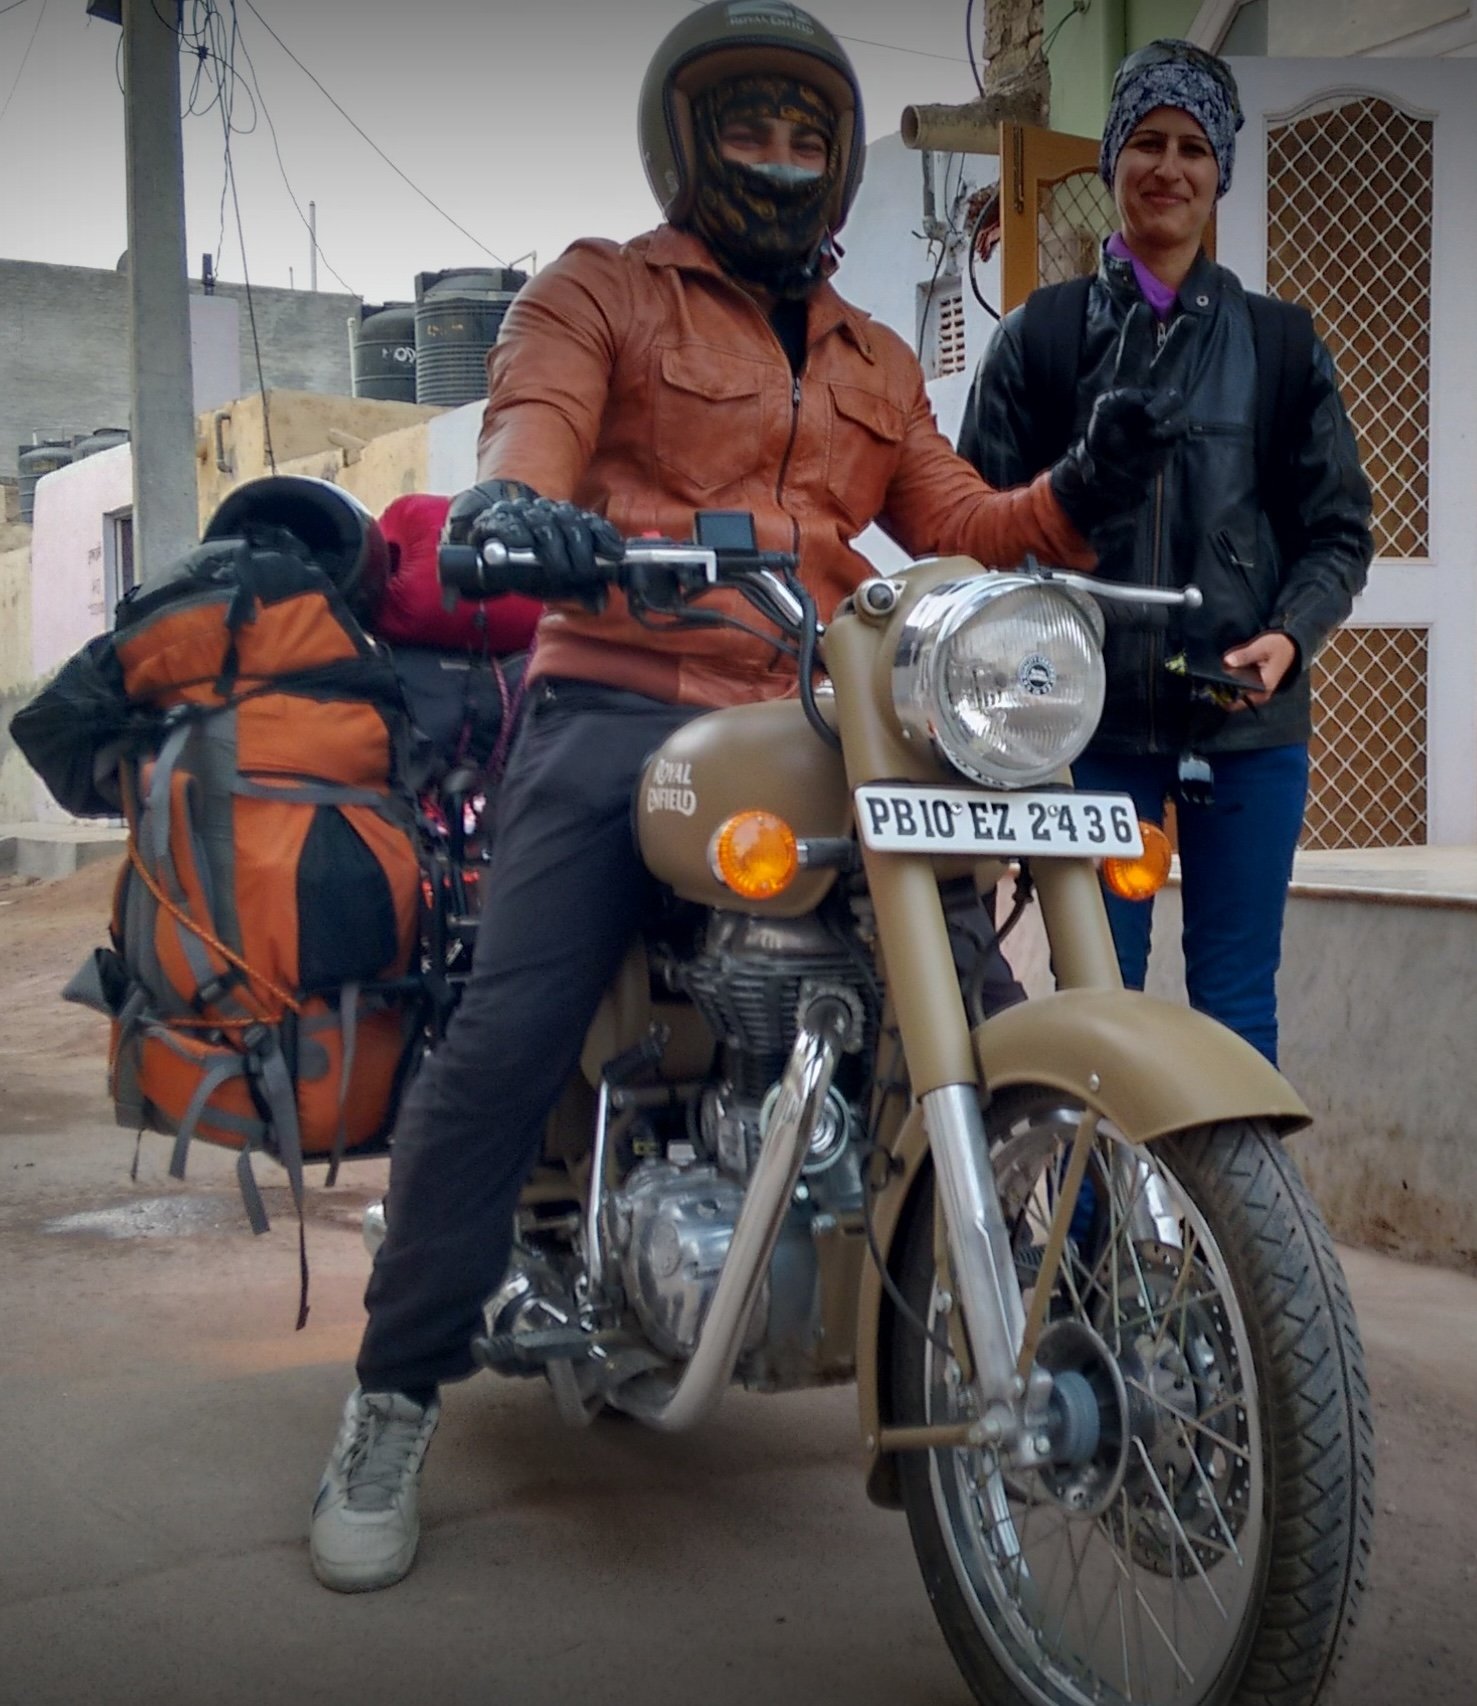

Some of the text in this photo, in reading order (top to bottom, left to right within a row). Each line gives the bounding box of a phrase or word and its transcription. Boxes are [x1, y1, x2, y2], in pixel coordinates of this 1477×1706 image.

[866, 797, 1133, 843] PB10 EZ 2436
